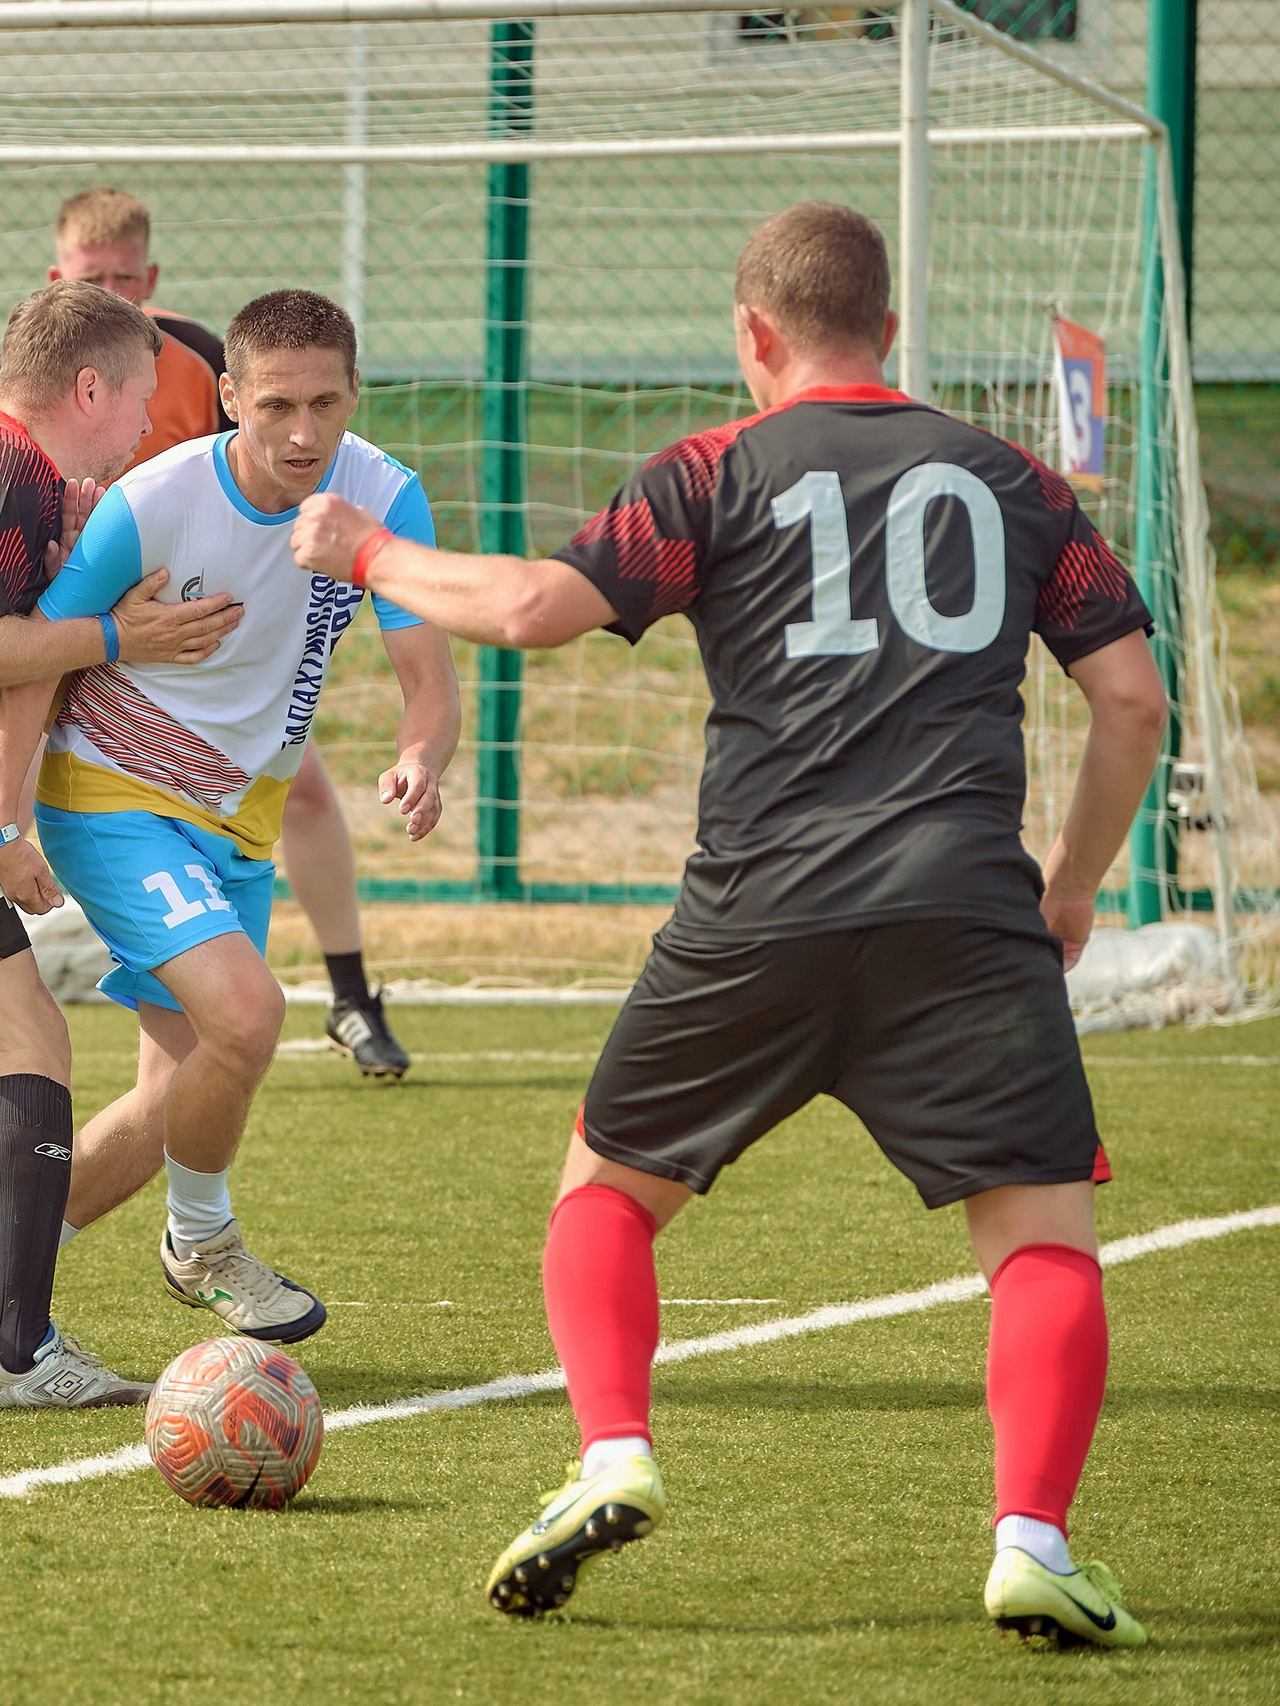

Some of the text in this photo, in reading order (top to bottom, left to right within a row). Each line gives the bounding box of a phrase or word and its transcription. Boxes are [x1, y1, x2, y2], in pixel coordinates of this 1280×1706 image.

[771, 461, 1006, 659] 10
[281, 570, 337, 750] БАЛАХТИНСКО
[141, 864, 232, 930] 11
